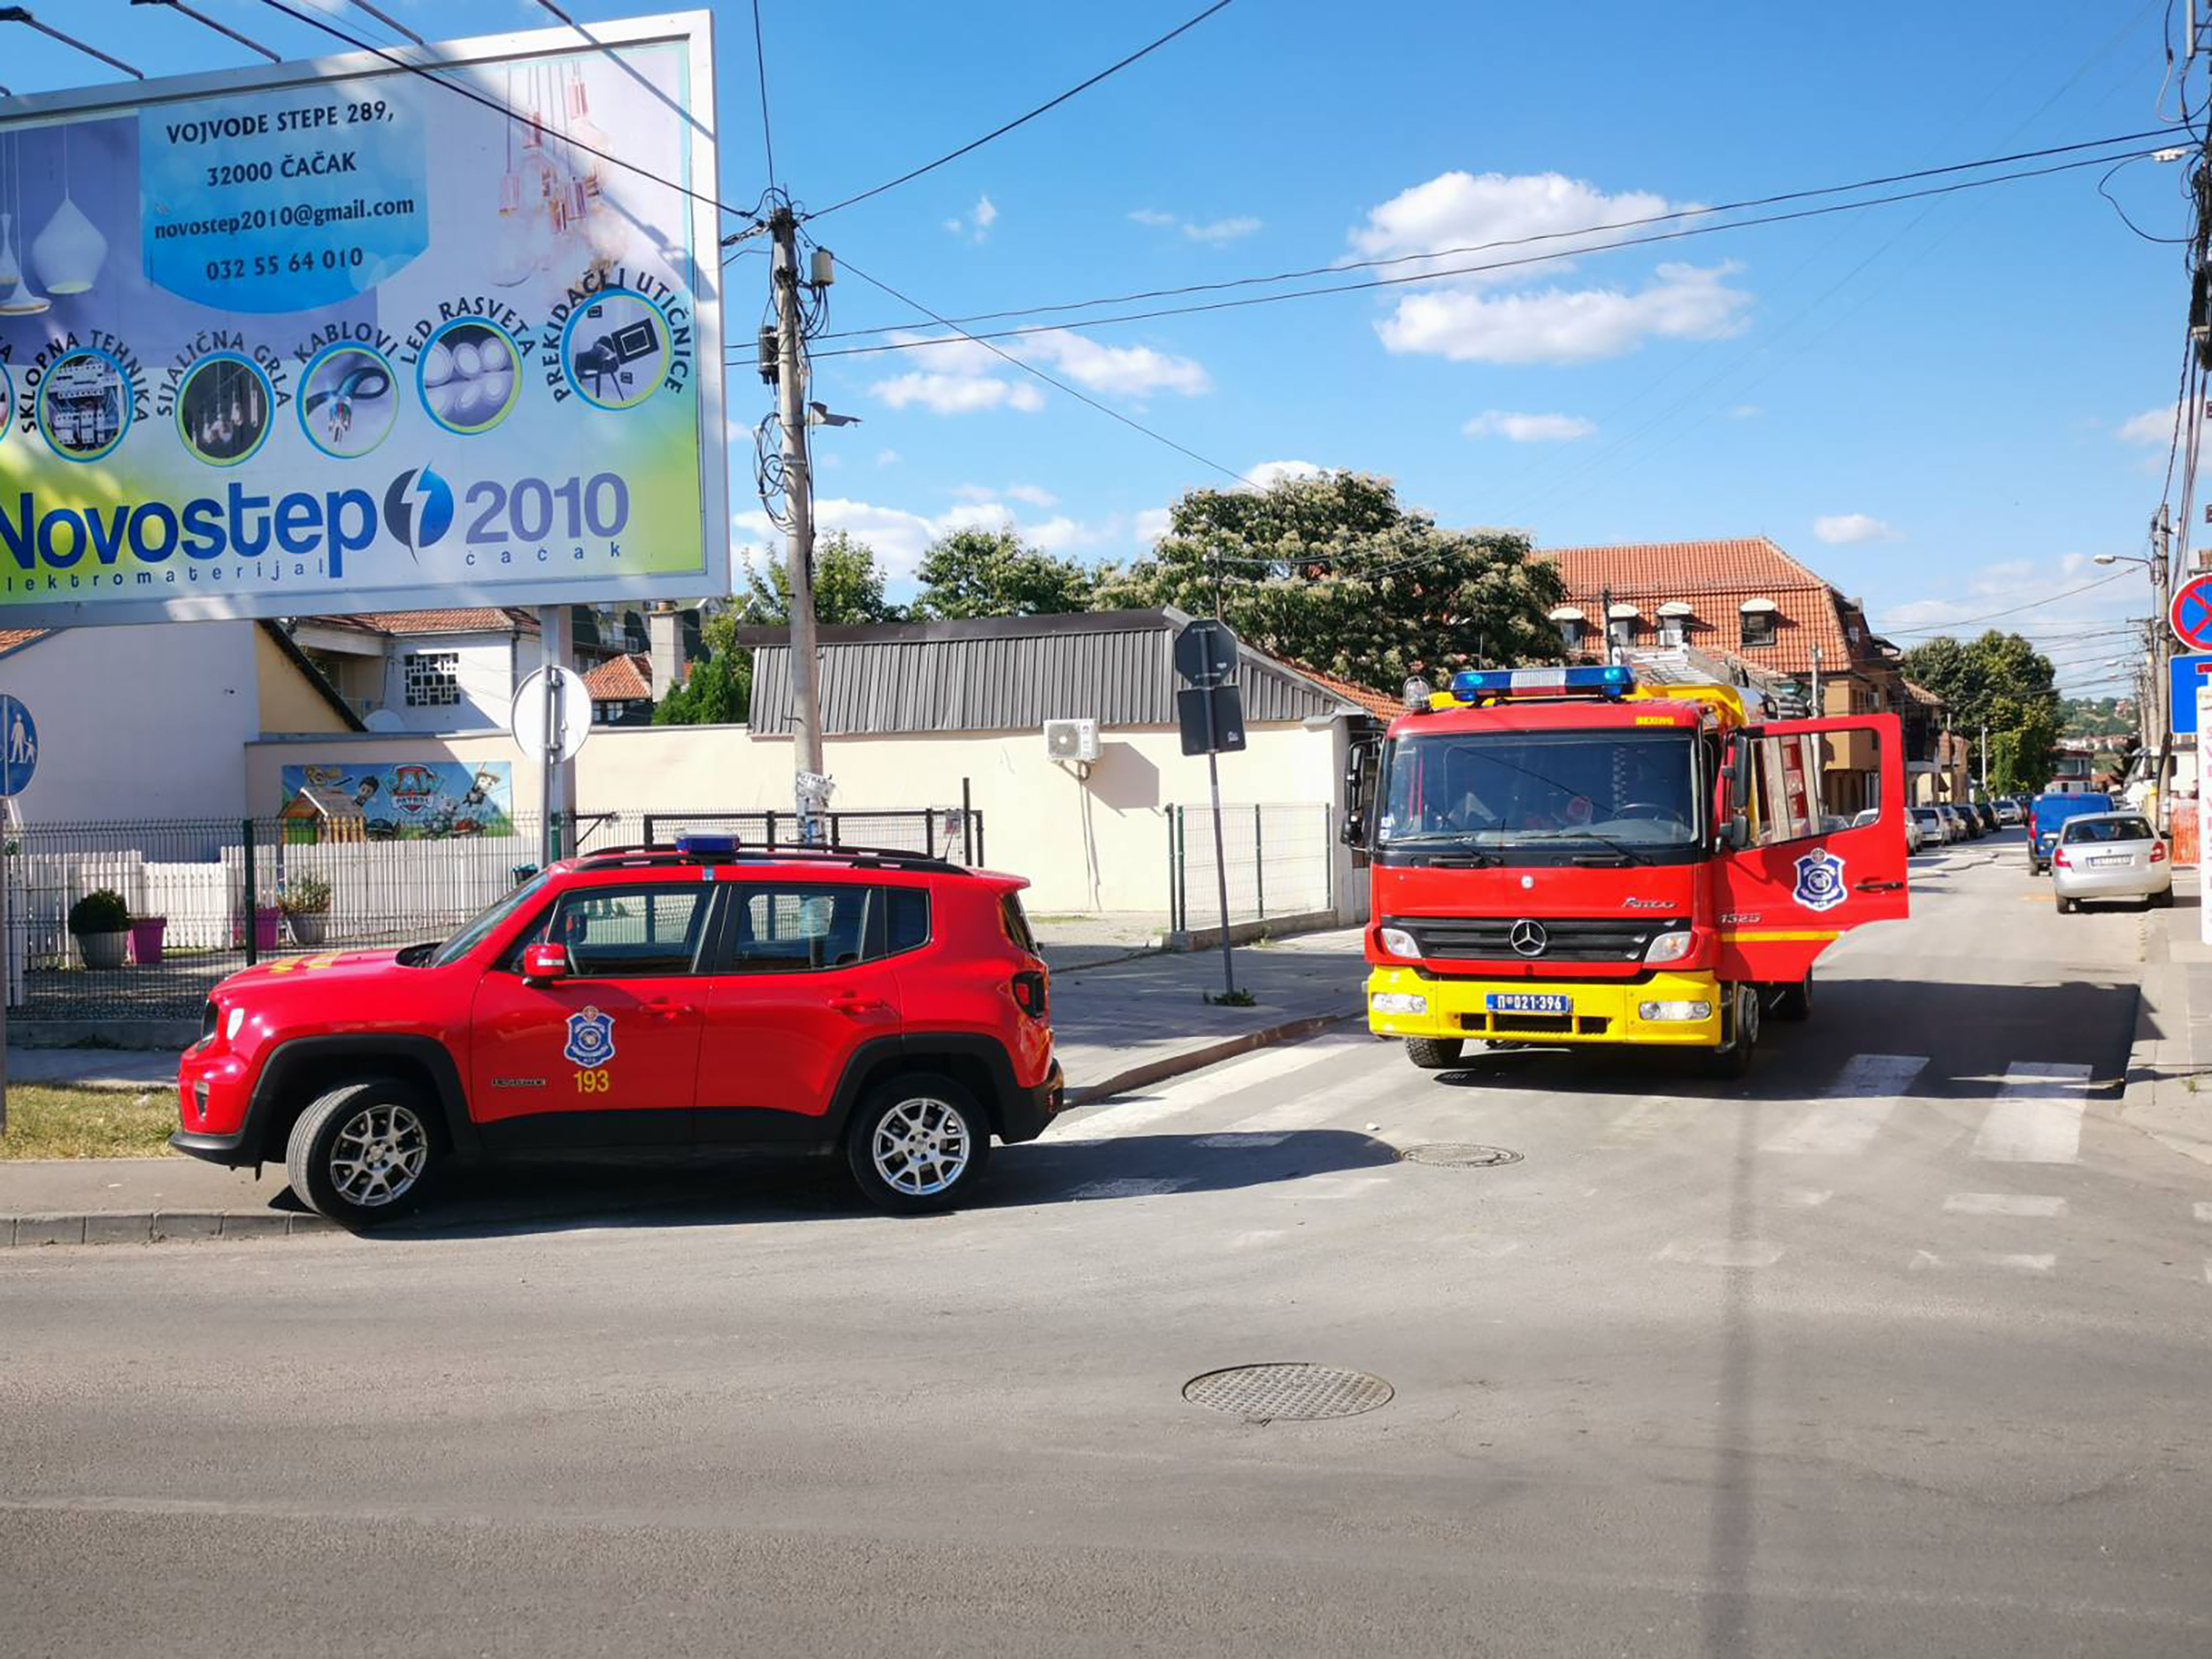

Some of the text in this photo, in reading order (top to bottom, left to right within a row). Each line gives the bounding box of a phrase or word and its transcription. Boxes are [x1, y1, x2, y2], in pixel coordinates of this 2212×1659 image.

[166, 100, 395, 144] VOJVODE STEPE 289,
[206, 151, 357, 187] 32000 ČAČAK
[155, 199, 414, 239] novostep2010@gmail.com
[206, 248, 363, 280] 032 55 64 010
[293, 320, 398, 365] KABLOVI
[400, 296, 536, 365] LED RASVETA
[542, 268, 606, 403] PREKIDAČI
[636, 272, 692, 395] UTIČNICE
[19, 329, 150, 434] SKLOPNA TEHNIKA
[157, 330, 293, 418] SIJALIČNA GRLA
[0, 472, 629, 579] Novostep 2010
[573, 1070, 610, 1093] 193
